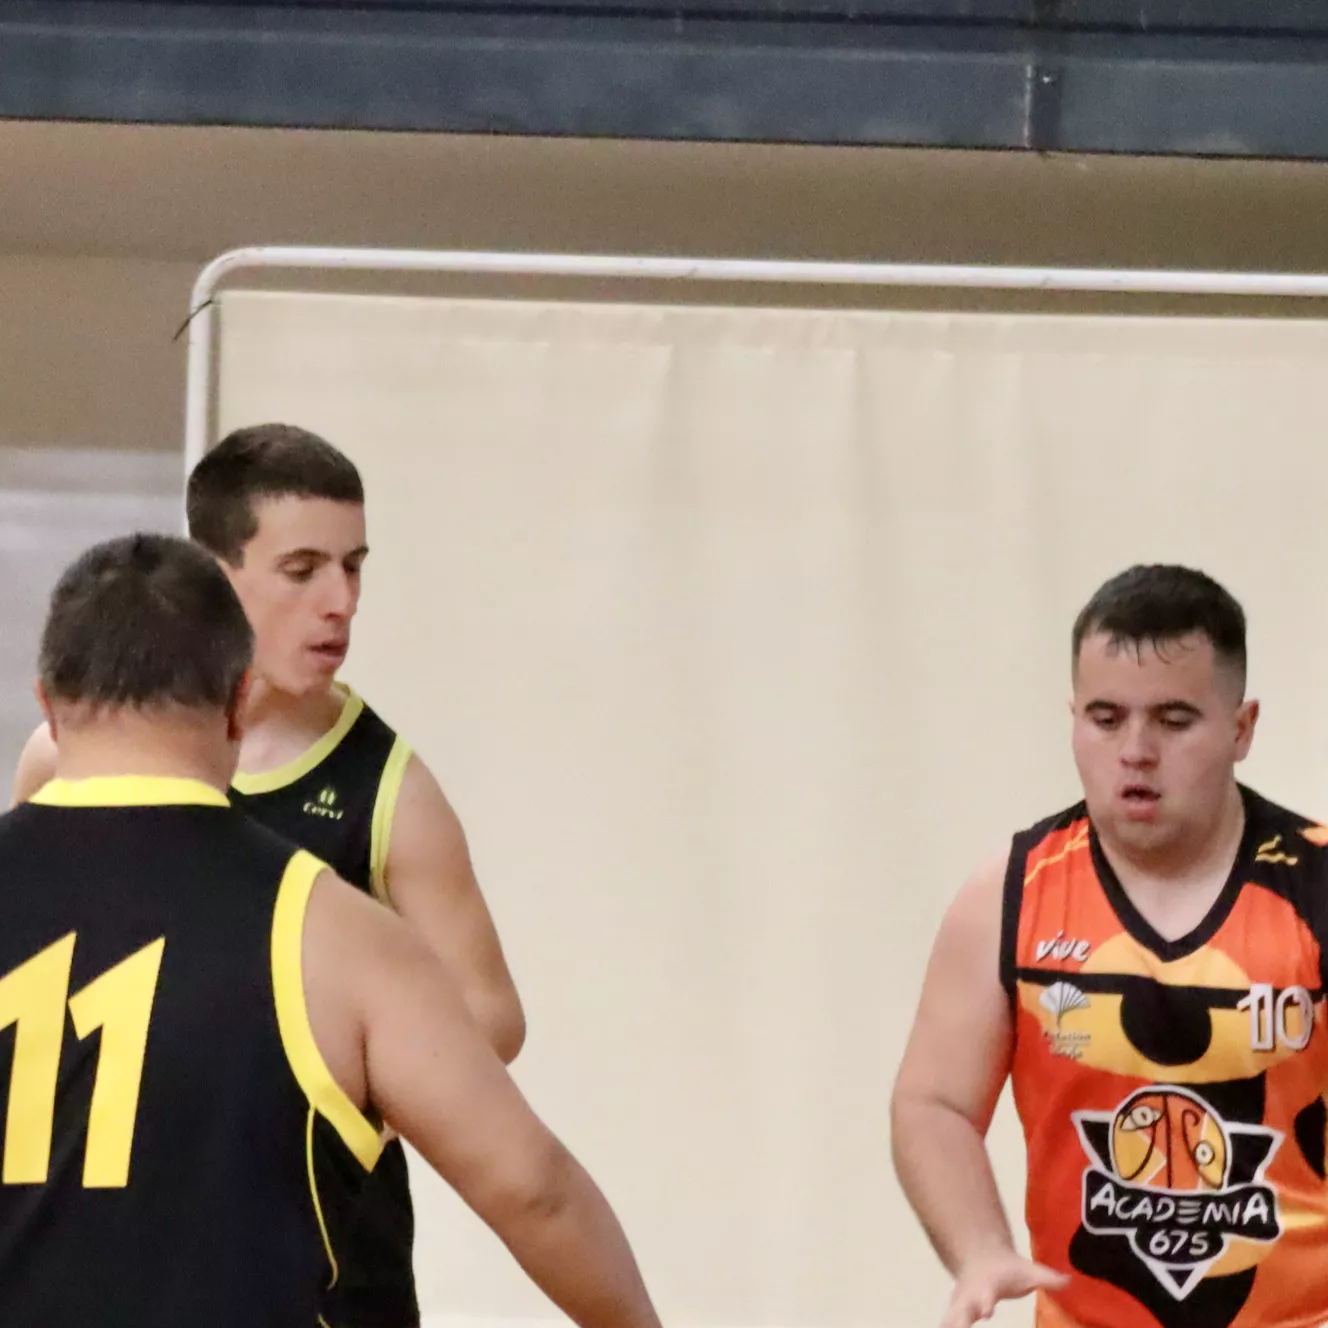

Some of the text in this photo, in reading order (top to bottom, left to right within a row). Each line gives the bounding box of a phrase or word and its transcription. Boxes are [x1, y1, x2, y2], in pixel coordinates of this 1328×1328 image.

[1236, 983, 1314, 1052] 10
[1090, 1182, 1268, 1225] ACADEMIA
[1149, 1229, 1209, 1256] 675
